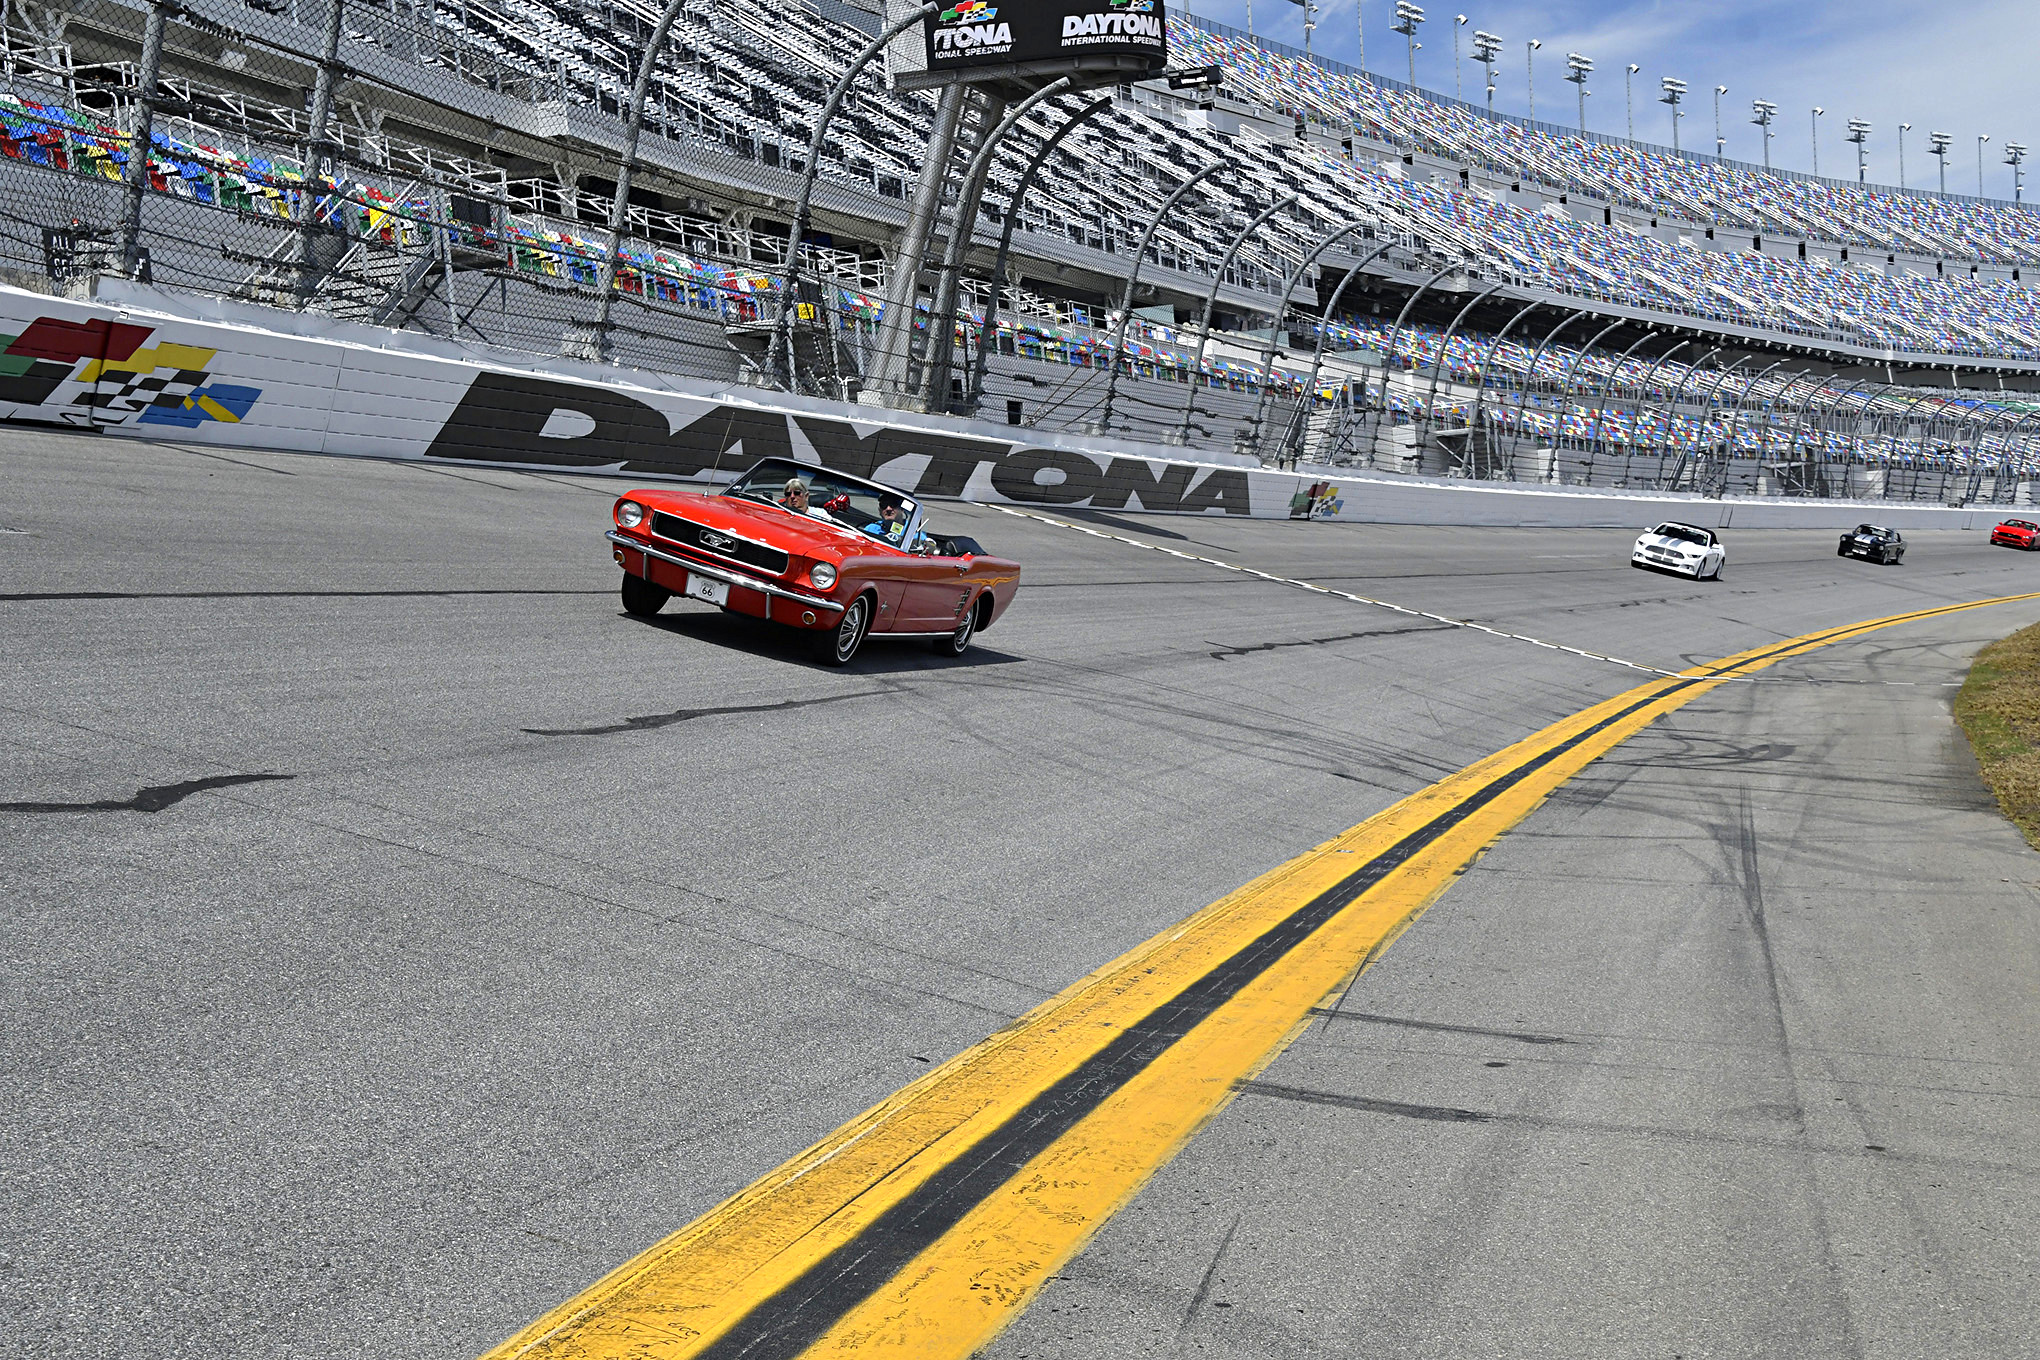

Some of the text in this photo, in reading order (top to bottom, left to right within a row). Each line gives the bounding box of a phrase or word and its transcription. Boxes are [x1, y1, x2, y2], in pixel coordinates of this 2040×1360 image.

[1062, 13, 1162, 38] DAYTONA
[1061, 35, 1162, 47] INTERNATIONAL SPEEDWAY
[964, 44, 1012, 57] SPEEDWAY
[424, 370, 1251, 516] DAYTONA
[701, 586, 713, 597] 66
